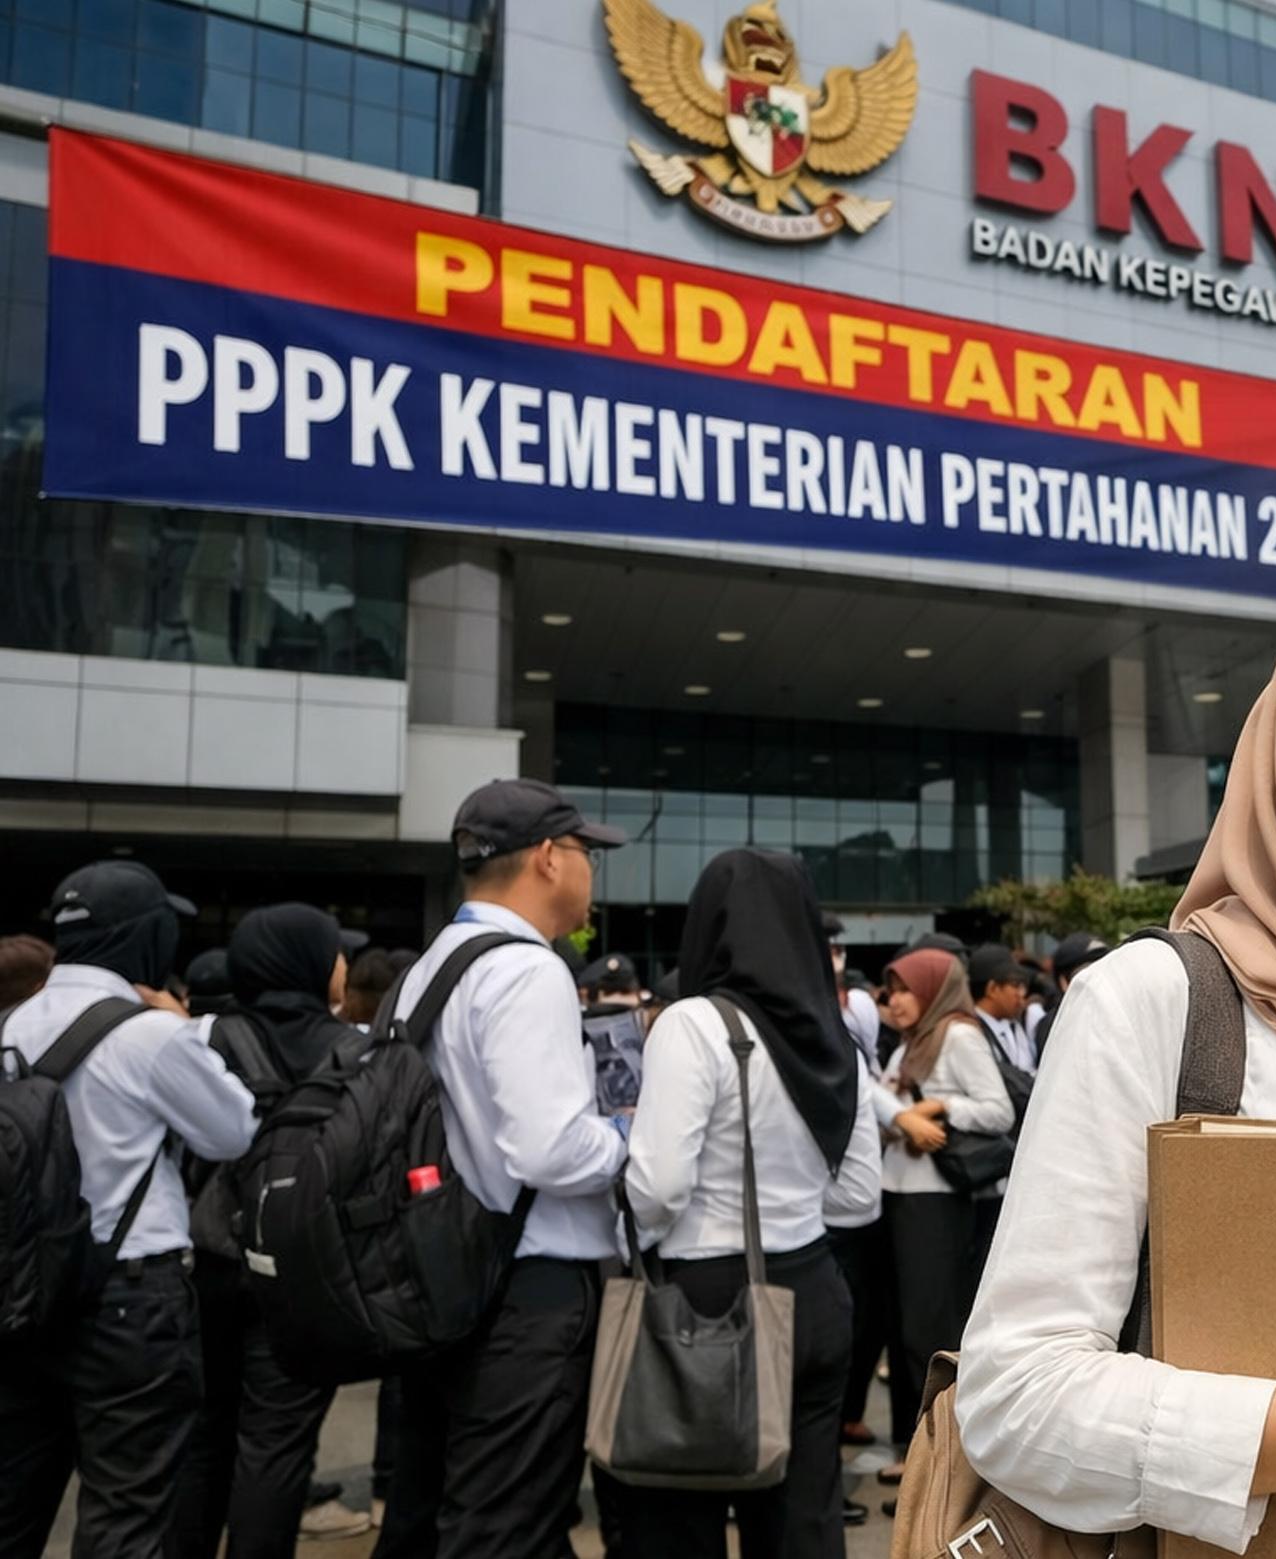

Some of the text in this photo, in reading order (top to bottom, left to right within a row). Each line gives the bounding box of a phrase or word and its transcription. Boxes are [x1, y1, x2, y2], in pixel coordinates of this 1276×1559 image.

[415, 231, 1202, 448] PENDAFTARAN
[972, 217, 1109, 282] BADAN
[138, 322, 414, 471] PPPK
[440, 372, 926, 525] KEMENTERIAN
[941, 451, 1248, 561] PERTAHANAN
